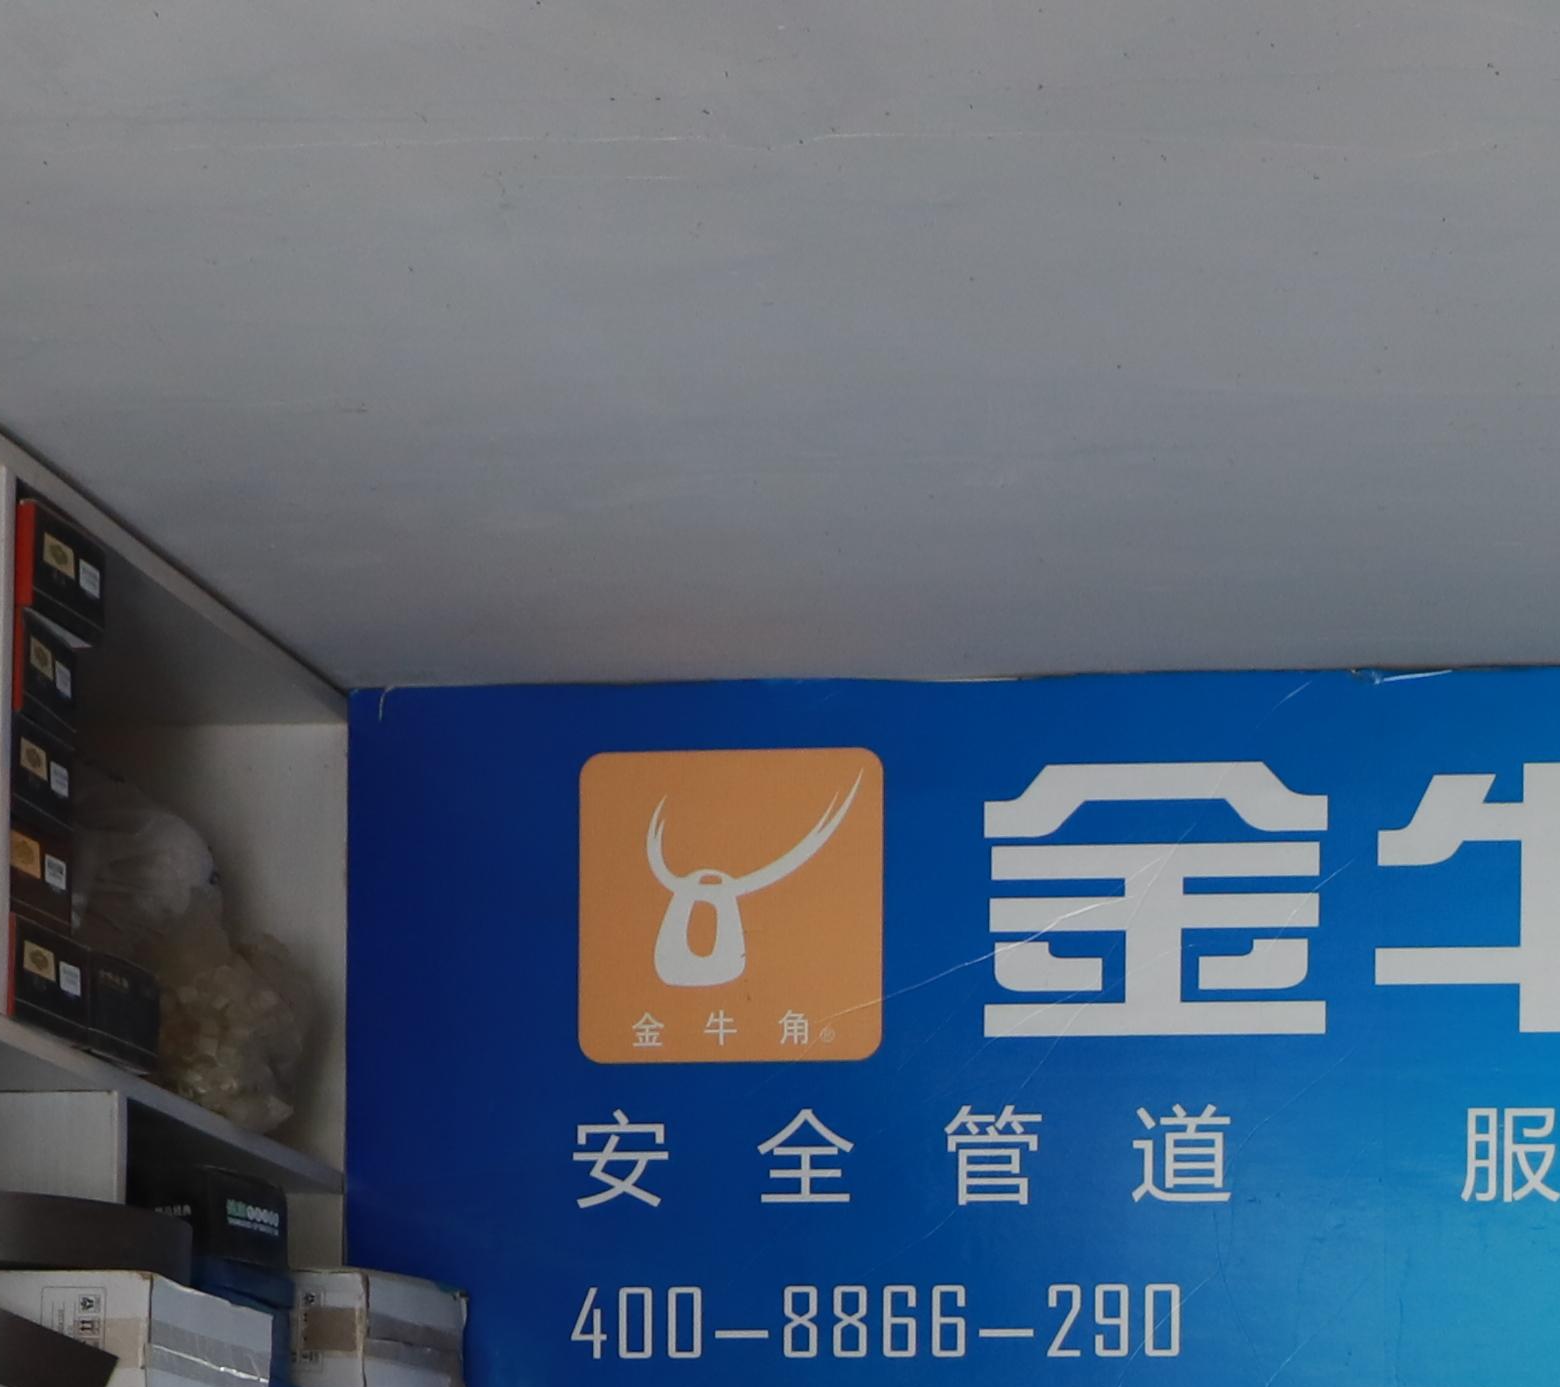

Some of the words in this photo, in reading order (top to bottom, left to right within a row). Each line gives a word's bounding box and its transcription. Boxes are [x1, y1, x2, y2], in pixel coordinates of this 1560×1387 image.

[630, 1008, 812, 1048] 金牛角
[571, 1103, 1232, 1210] 安全管道
[570, 1282, 1183, 1361] 400-8866-290
